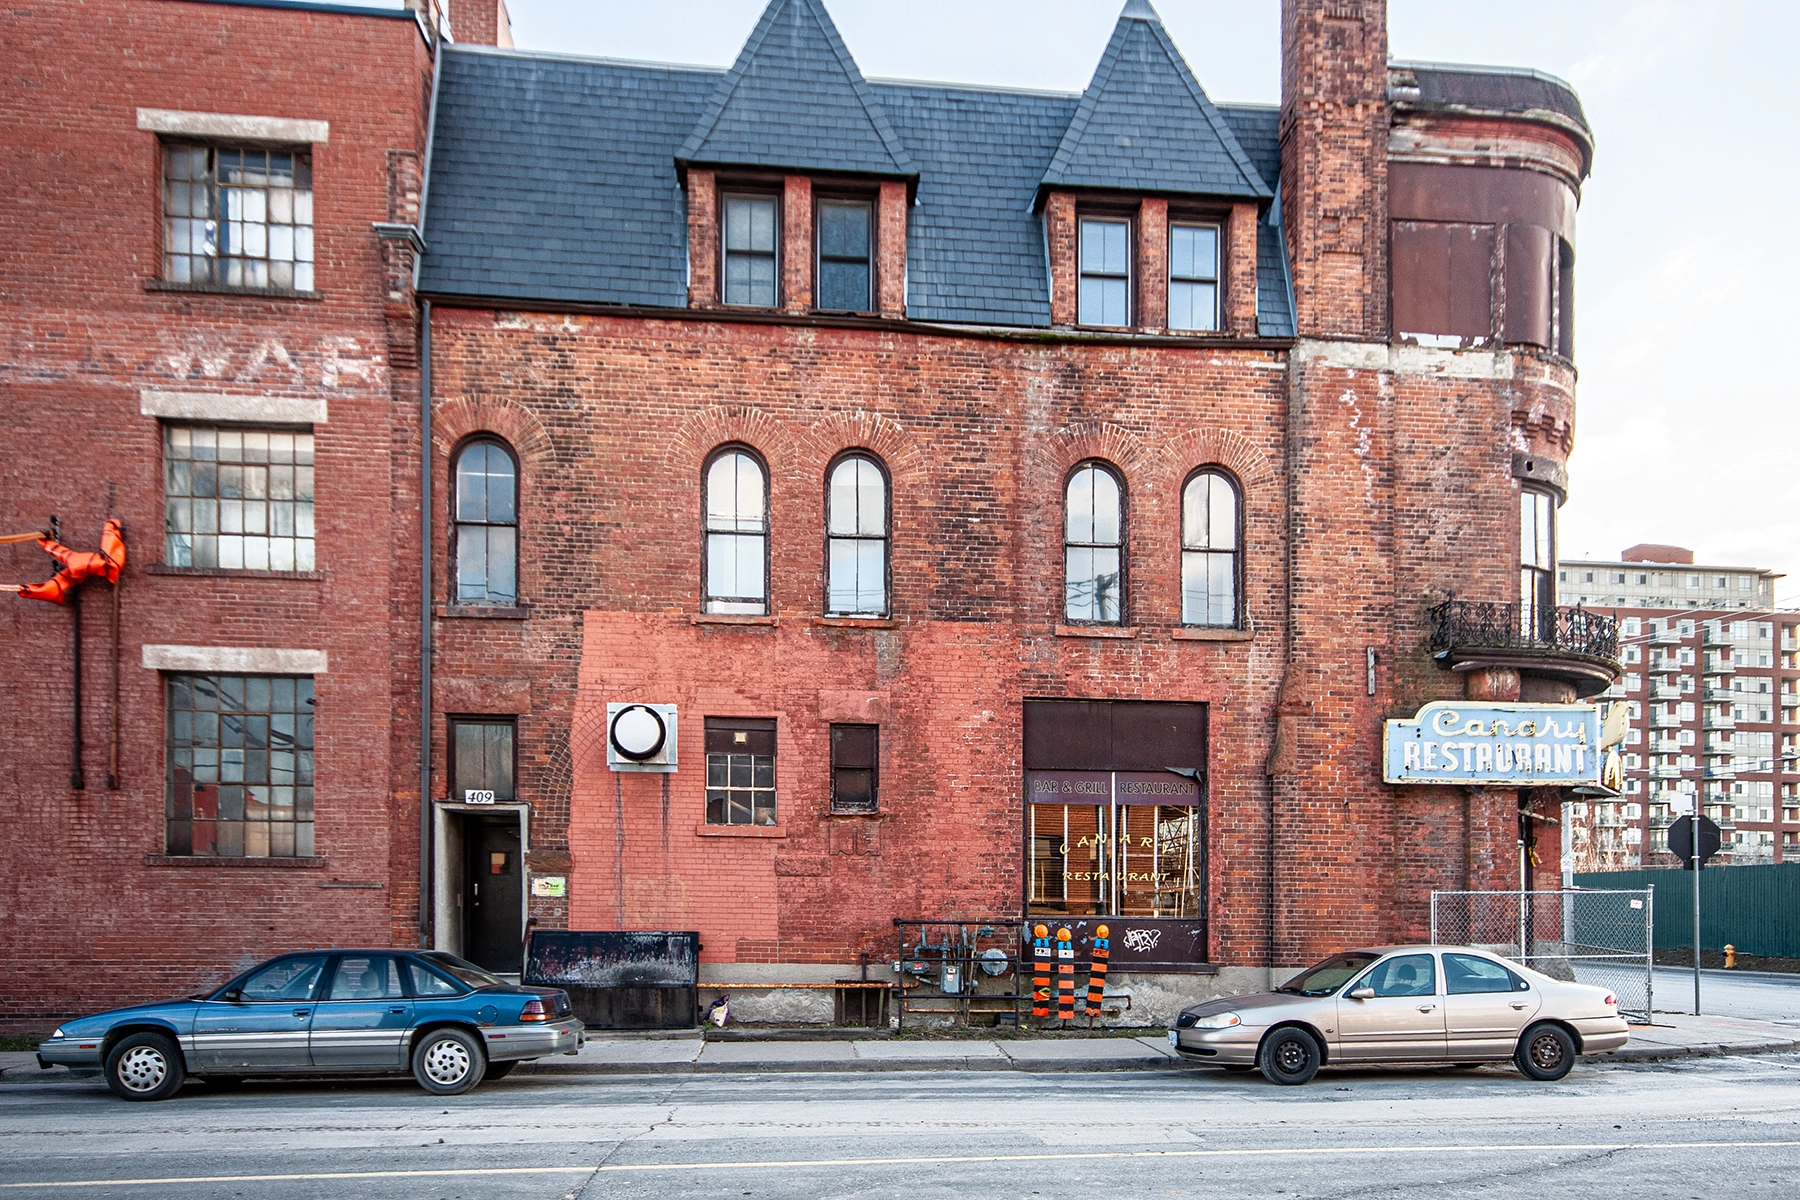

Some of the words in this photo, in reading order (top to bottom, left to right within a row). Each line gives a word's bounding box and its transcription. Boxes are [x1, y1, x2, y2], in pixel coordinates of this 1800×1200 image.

[1432, 710, 1586, 745] Canary
[1403, 741, 1588, 773] RESTAURANT
[1034, 781, 1059, 793] BAR
[1062, 781, 1073, 794] &
[1075, 781, 1108, 795] GRILL
[1120, 782, 1196, 796] RESTAURANT
[468, 791, 492, 802] 409
